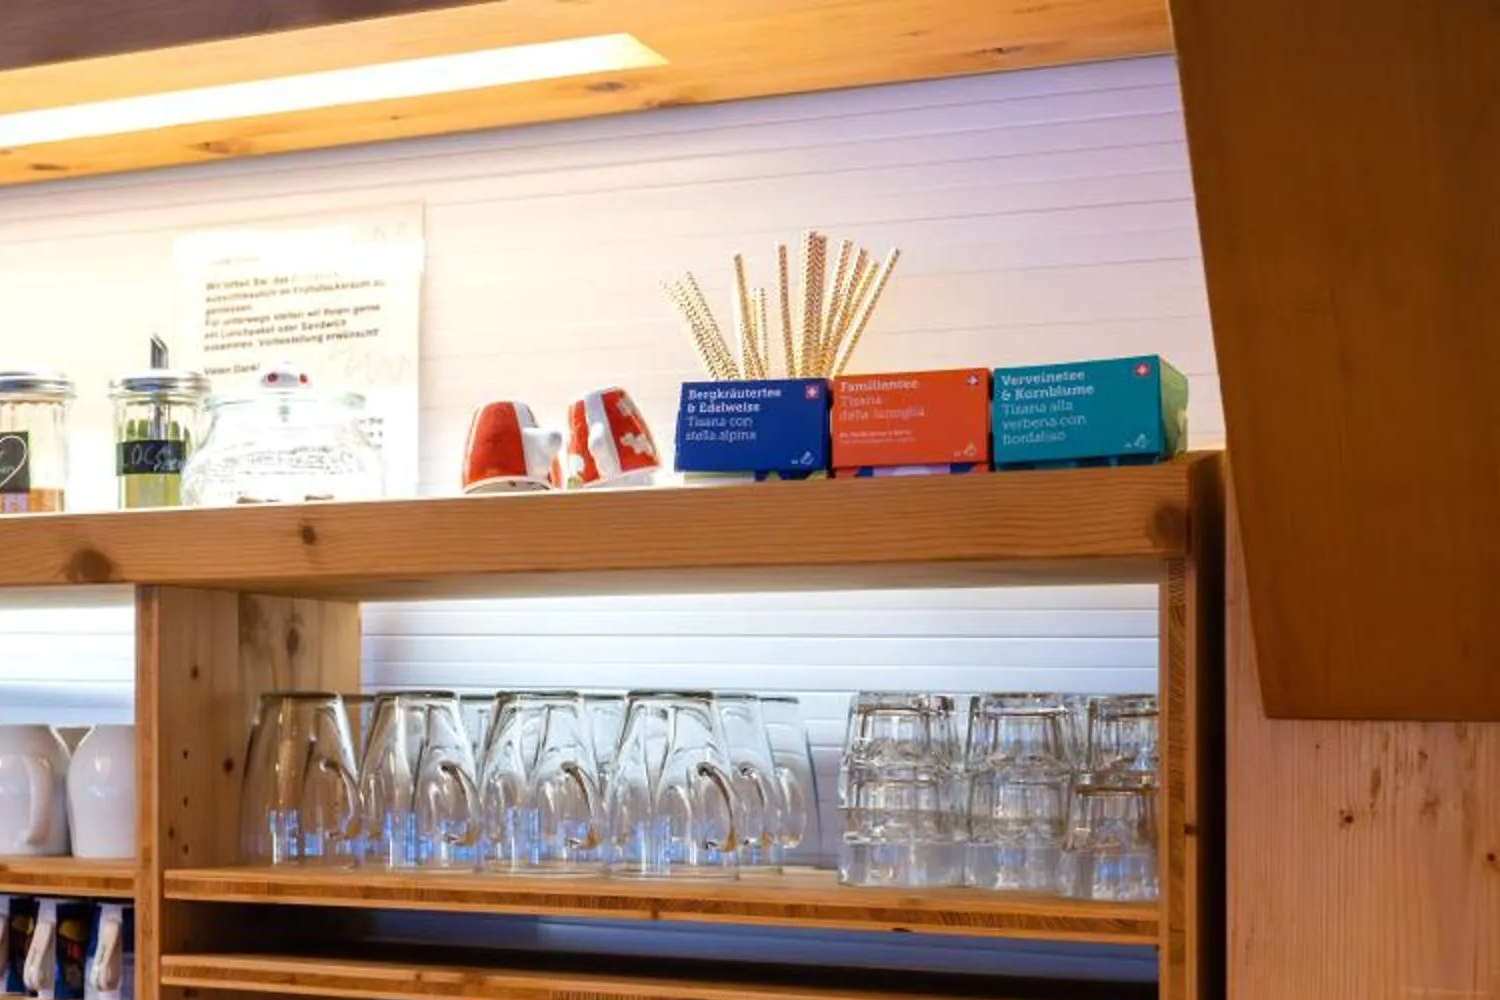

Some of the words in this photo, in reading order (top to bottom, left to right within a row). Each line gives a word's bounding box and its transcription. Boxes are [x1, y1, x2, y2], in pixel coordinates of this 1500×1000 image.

[1001, 371, 1086, 387] Verveinetee
[687, 387, 782, 402] Bergkräutertee
[1014, 385, 1095, 401] Kornblume
[699, 402, 761, 414] Edelweiss
